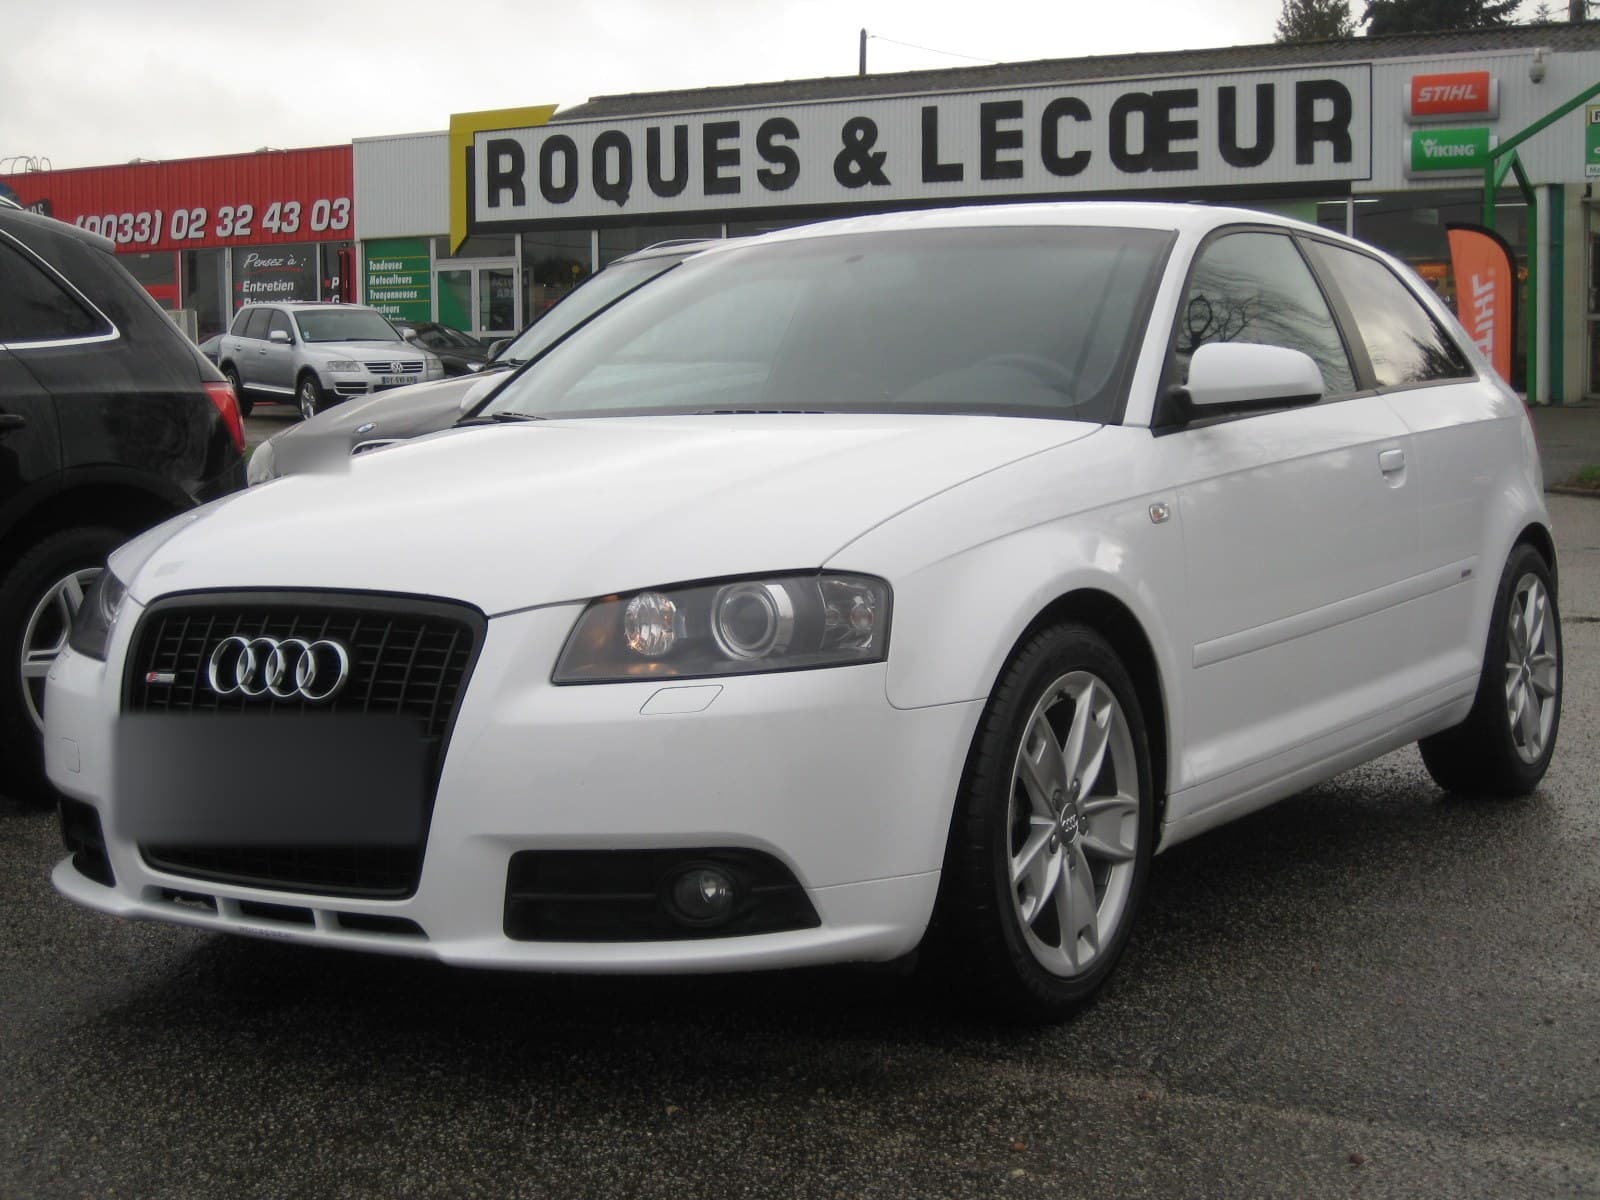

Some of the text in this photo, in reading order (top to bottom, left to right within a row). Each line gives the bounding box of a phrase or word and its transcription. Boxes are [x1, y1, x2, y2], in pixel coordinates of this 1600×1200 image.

[1417, 84, 1478, 102] STIHL
[487, 79, 1352, 208] ROQUES & LECŒUR
[1422, 141, 1475, 158] VIKING
[171, 208, 207, 240] 02
[215, 205, 253, 237] 32
[262, 202, 301, 233] 43
[310, 198, 350, 231] 03
[243, 253, 284, 268] Pensez
[369, 260, 402, 271] Tondeuses
[242, 280, 294, 292] Entretien
[1472, 273, 1495, 363] TIHL
